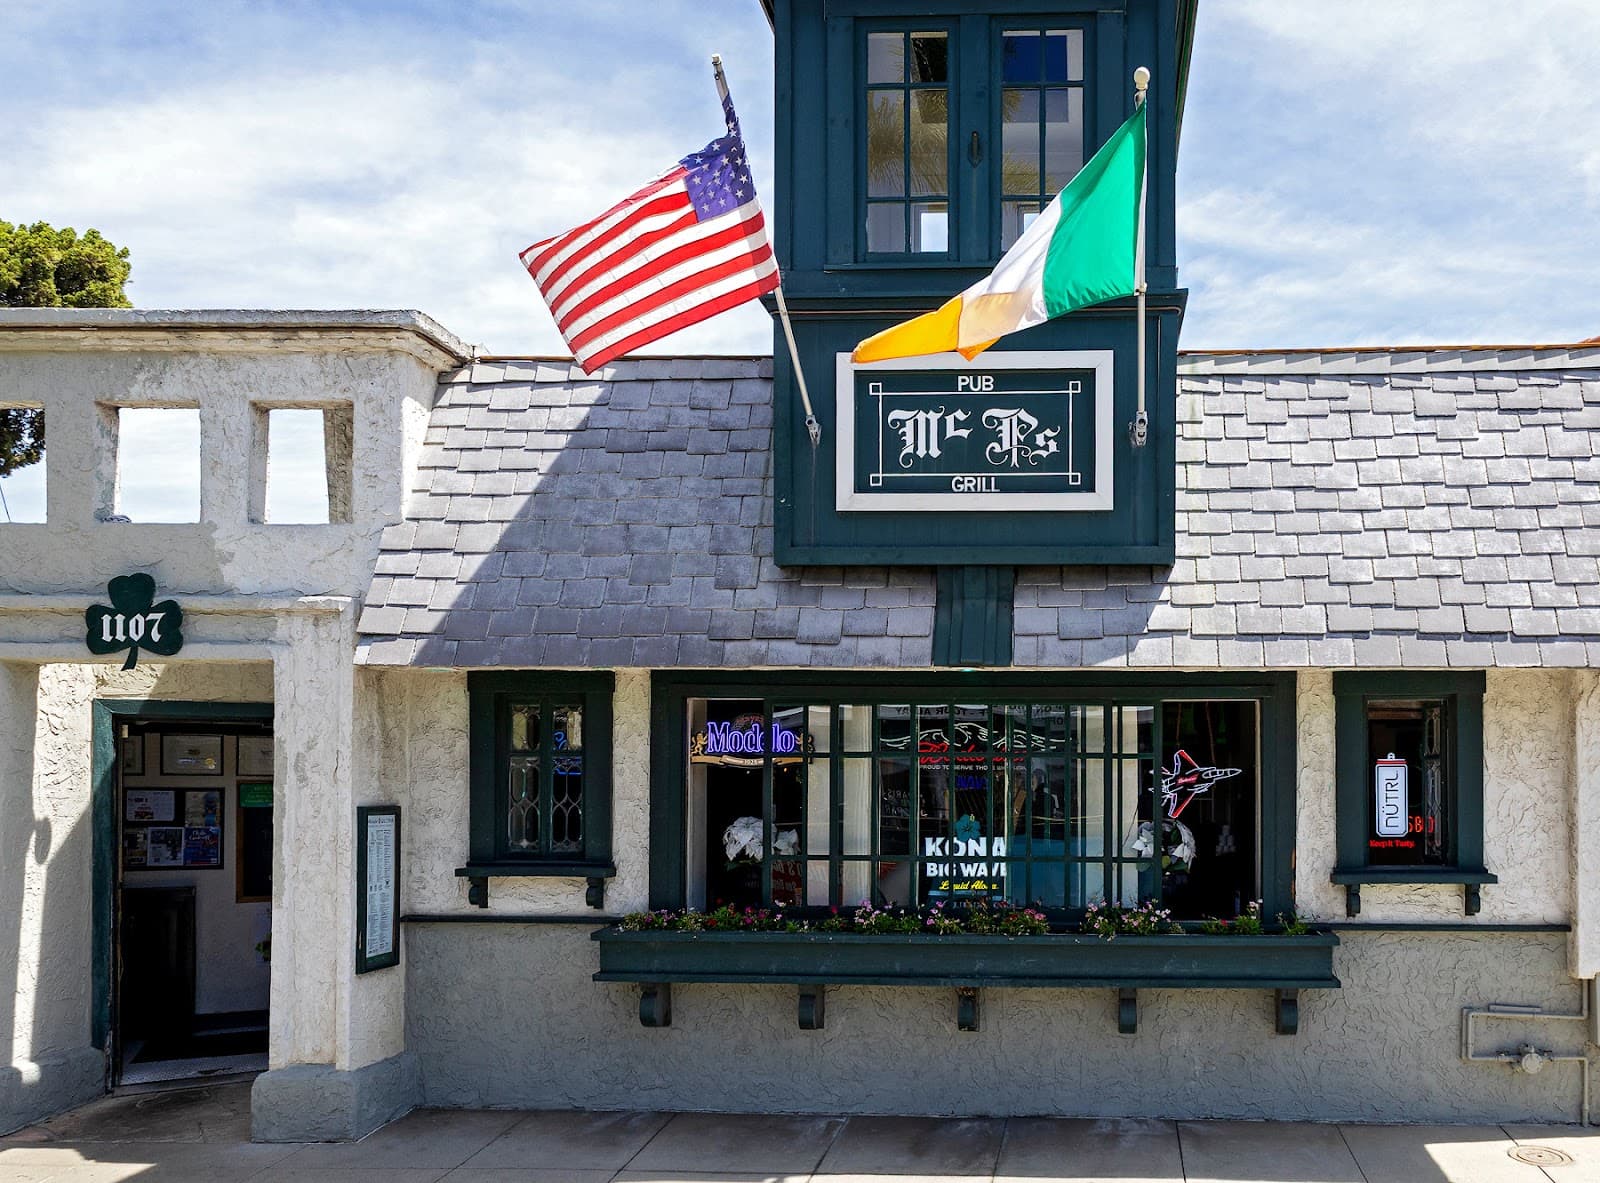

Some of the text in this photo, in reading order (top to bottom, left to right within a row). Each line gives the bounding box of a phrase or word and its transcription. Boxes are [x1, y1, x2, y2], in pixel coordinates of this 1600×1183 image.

[957, 375, 995, 392] PUB
[951, 476, 1000, 493] GRILL
[101, 612, 166, 643] 1107
[924, 836, 1007, 857] KONA
